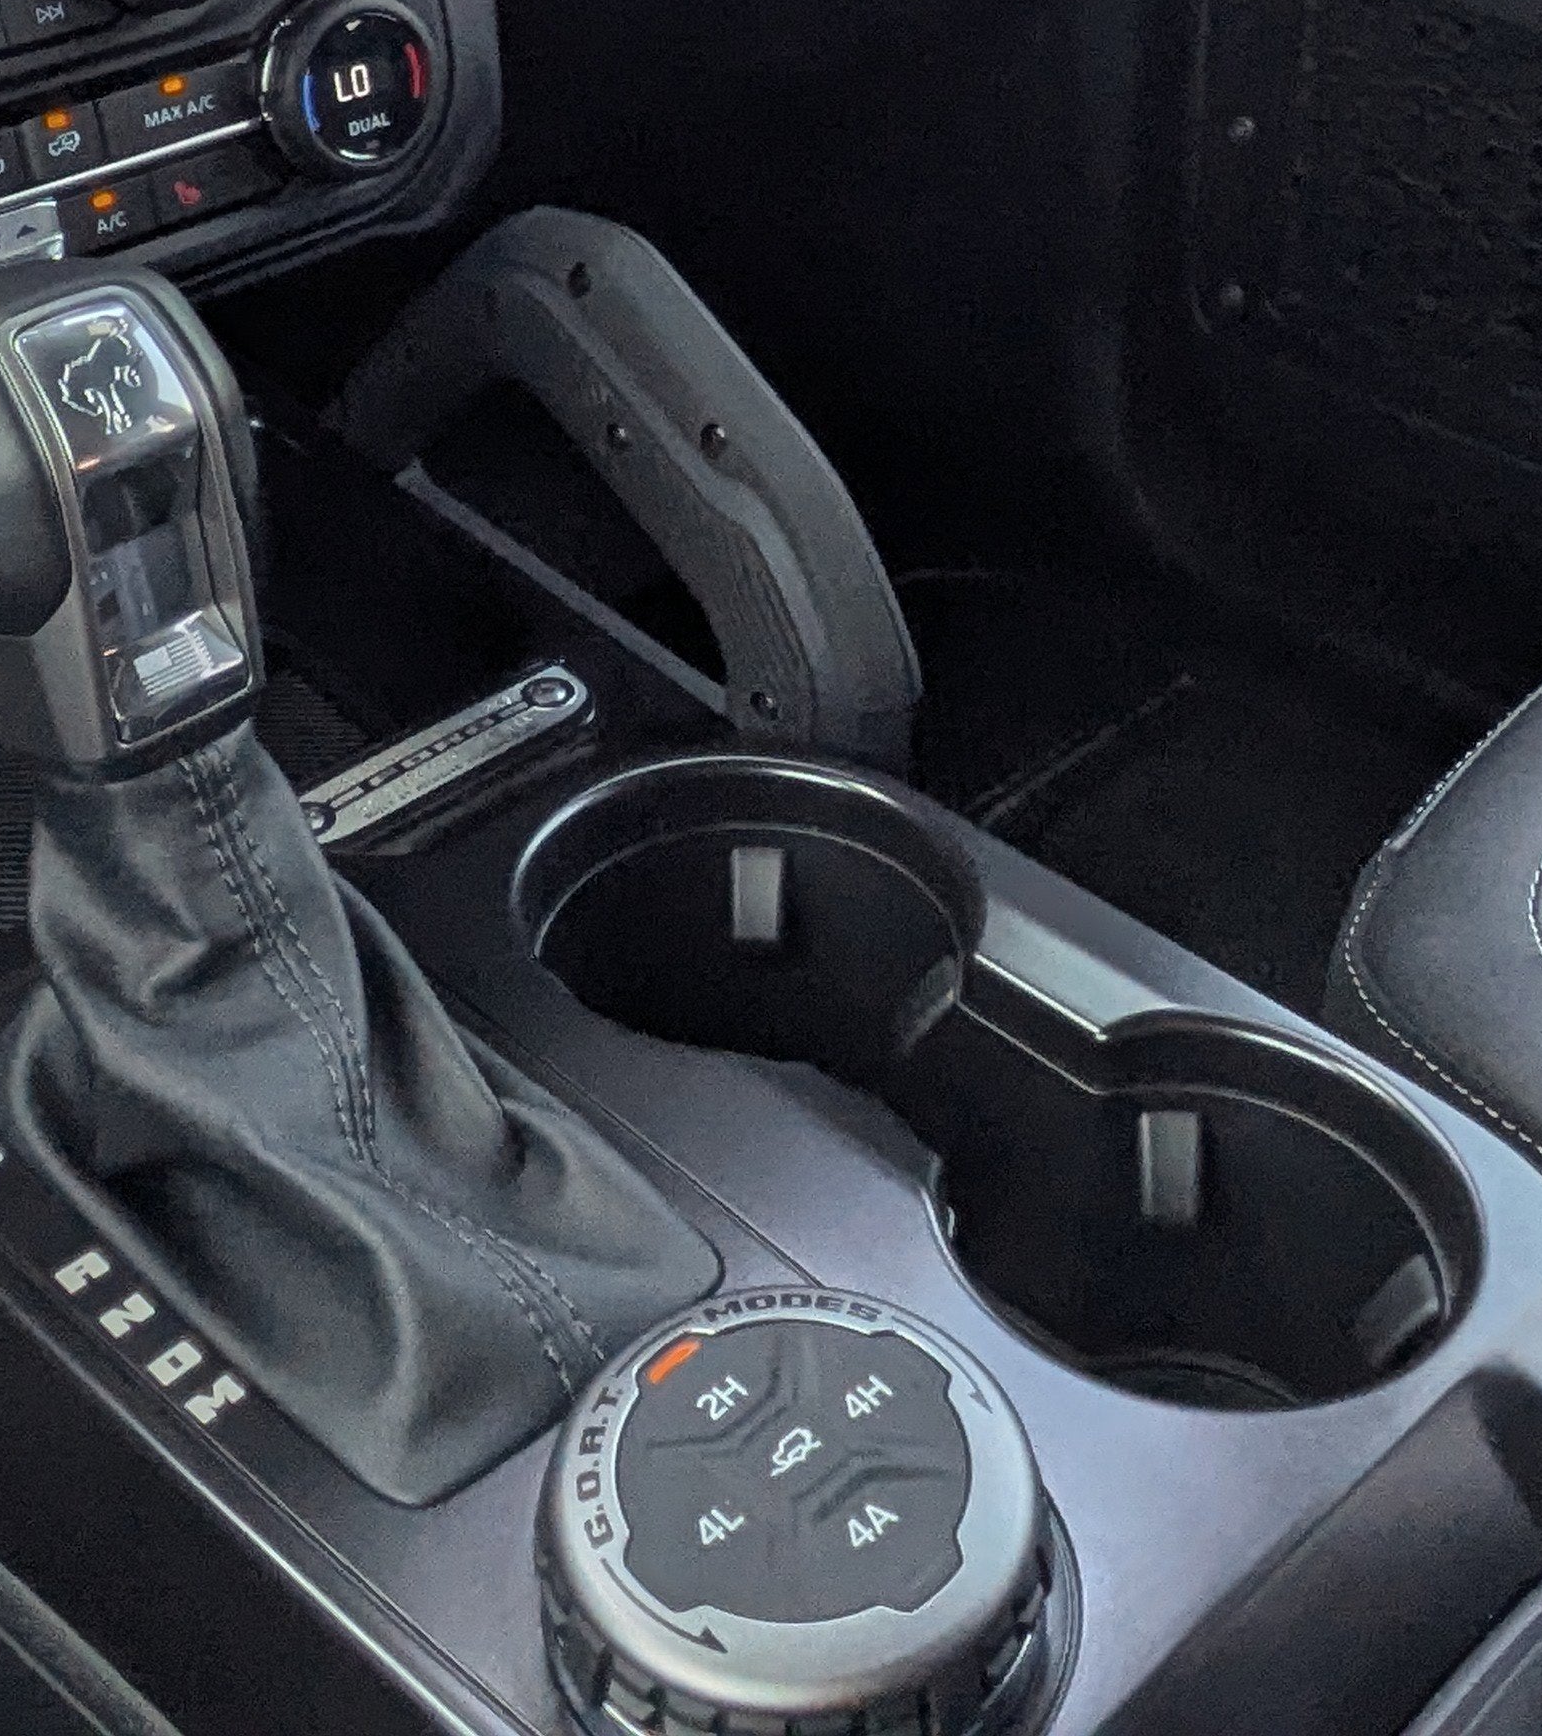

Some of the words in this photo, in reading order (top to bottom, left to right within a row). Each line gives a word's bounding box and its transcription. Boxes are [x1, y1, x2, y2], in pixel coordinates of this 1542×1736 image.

[334, 65, 371, 102] LO
[144, 103, 183, 129] MAX
[186, 94, 216, 117] A/C
[348, 113, 391, 137] DUAL
[96, 211, 128, 235] A/C
[99, 1293, 156, 1339] N
[704, 1292, 882, 1323] MODES
[148, 1341, 202, 1386] D
[696, 1374, 749, 1421] 2H
[844, 1374, 894, 1420] 4H
[696, 1507, 746, 1546] 4L
[845, 1503, 900, 1549] 4A
